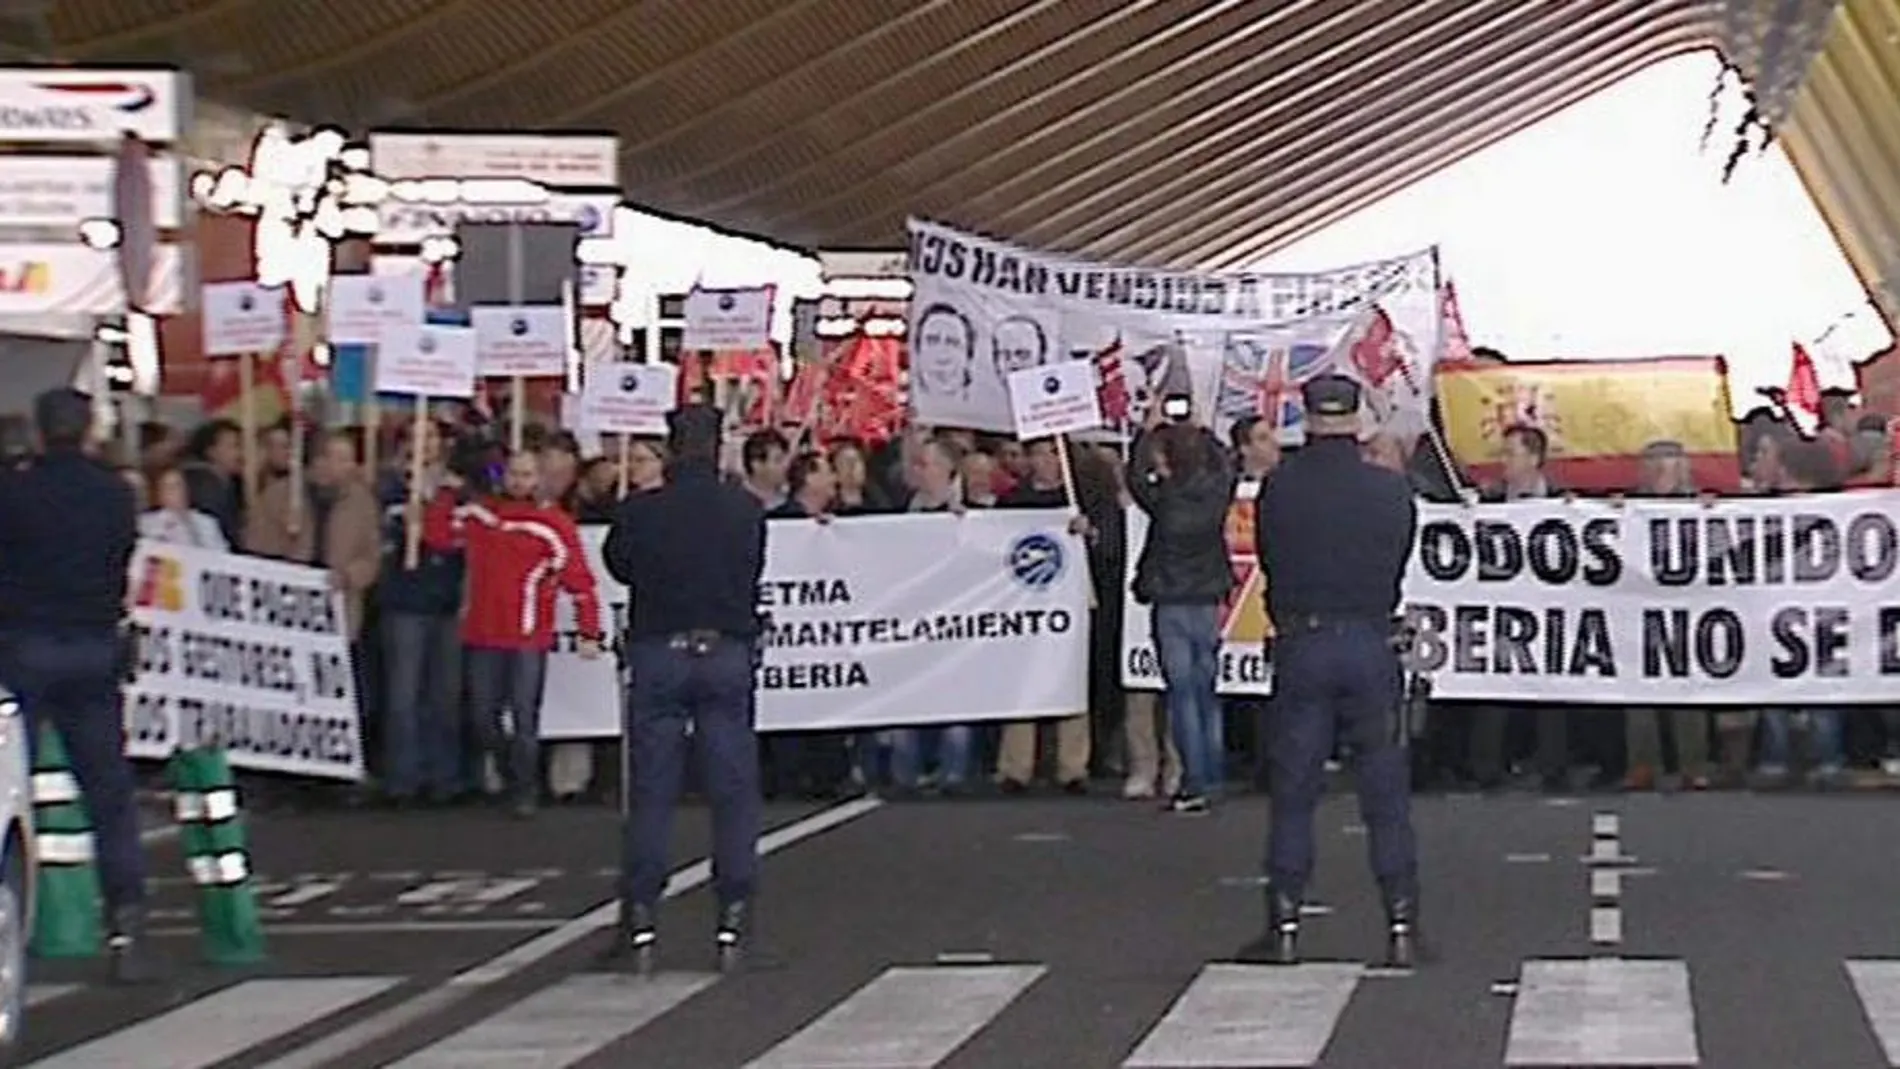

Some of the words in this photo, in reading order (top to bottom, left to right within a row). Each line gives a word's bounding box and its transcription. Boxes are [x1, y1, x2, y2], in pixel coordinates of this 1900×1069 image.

[969, 247, 1047, 295] HAN
[1420, 519, 1623, 584] ODOS
[1649, 512, 1899, 586] UNIDO
[200, 569, 245, 622] QUE
[249, 577, 338, 634] PAGUEN
[1404, 604, 1620, 677] BERIA
[1643, 609, 1744, 678] NO
[1771, 608, 1849, 678] SE
[310, 650, 346, 700] NO
[763, 661, 868, 689] BERIA
